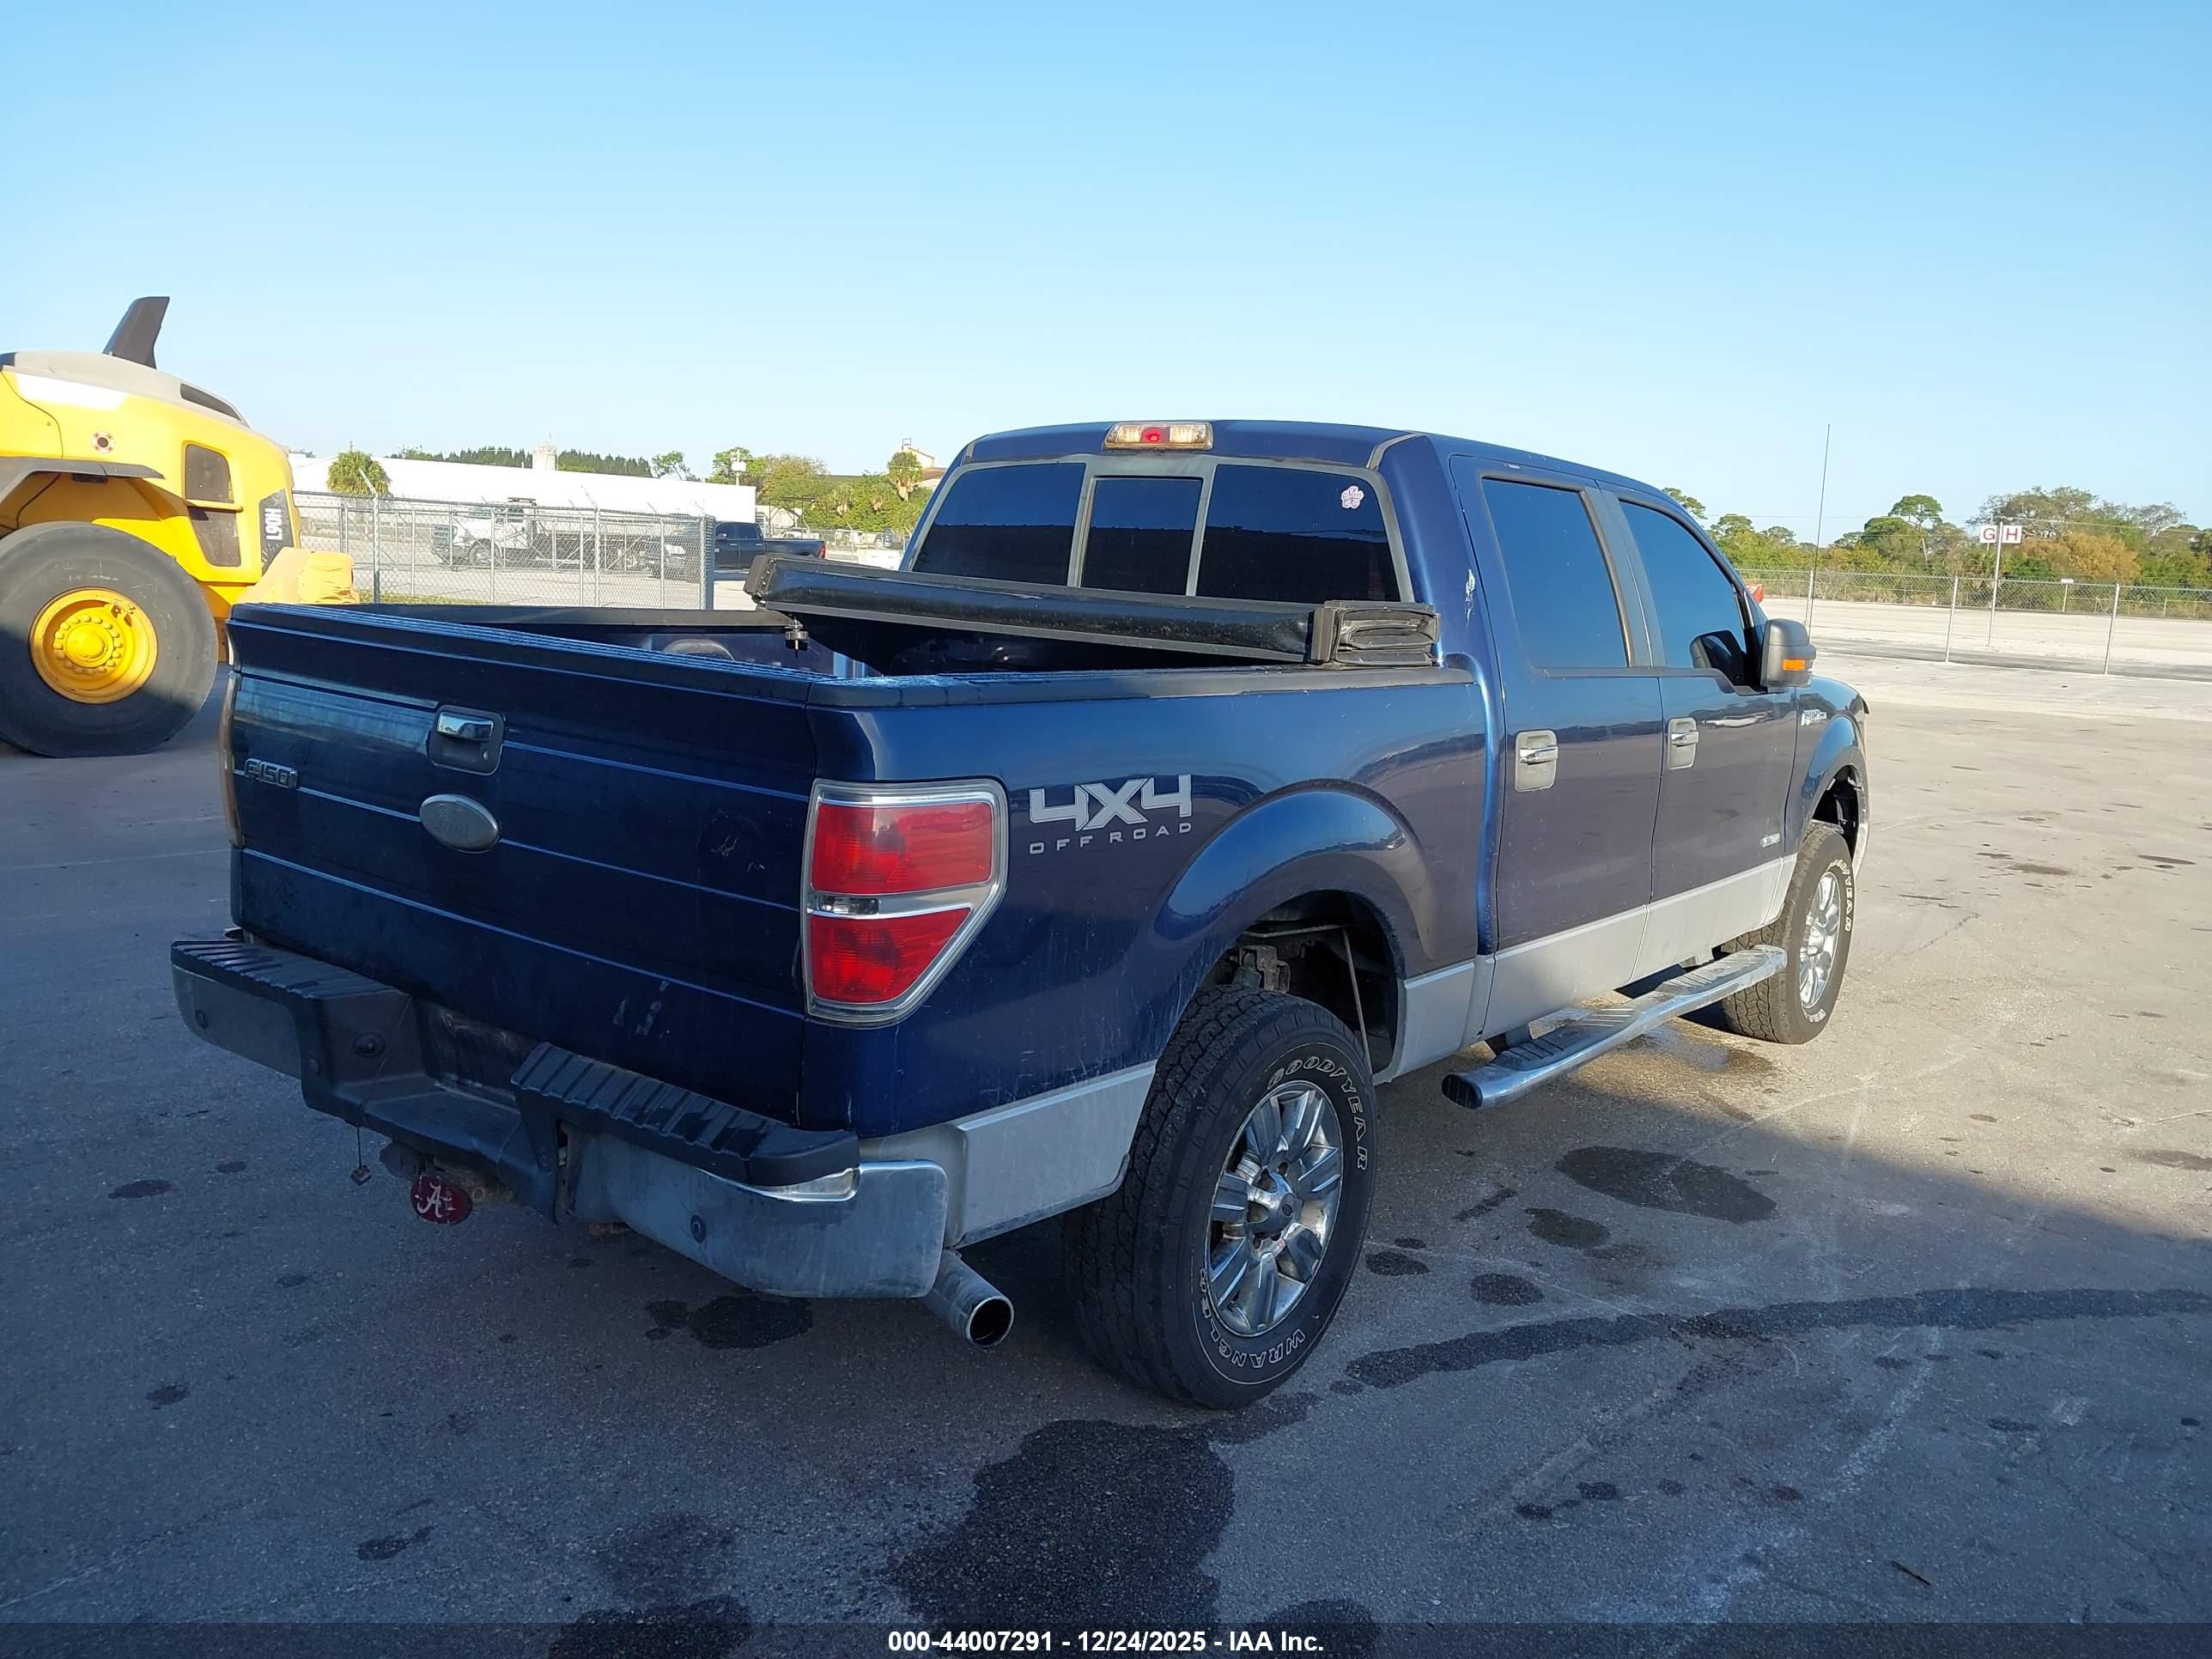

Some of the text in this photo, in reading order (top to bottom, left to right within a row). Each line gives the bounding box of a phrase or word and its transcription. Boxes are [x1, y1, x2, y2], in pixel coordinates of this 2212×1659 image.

[264, 507, 283, 540] L90H
[1984, 527, 1996, 541] G
[2006, 527, 2018, 541] H
[1029, 822, 1192, 855] OFF ROAD
[1267, 1055, 1368, 1170] GOODYEAR
